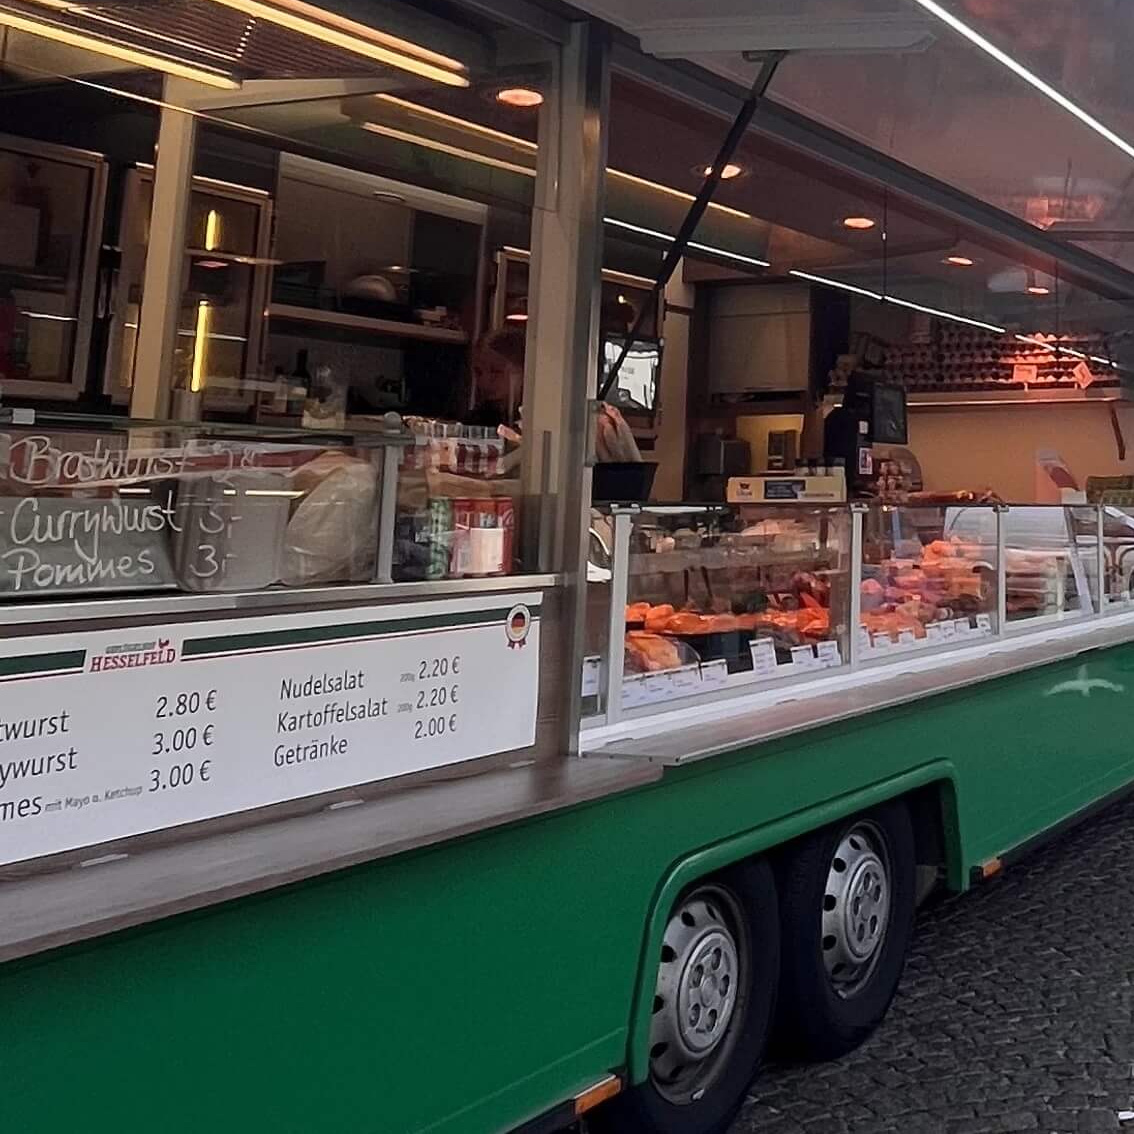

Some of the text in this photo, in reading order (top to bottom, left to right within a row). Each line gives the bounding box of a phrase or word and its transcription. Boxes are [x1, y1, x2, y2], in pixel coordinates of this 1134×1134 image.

[2, 549, 155, 590] Pommes
[89, 648, 177, 673] HESSELFELD
[279, 669, 365, 701] Nudelsalat
[418, 657, 449, 680] 2.20
[451, 655, 461, 675] €
[155, 691, 201, 718] 2.80
[205, 689, 218, 712] €
[277, 697, 389, 734] Kartoffelsalat
[416, 686, 447, 709] 2.20
[450, 684, 459, 704] €
[151, 726, 198, 755] 3.00
[202, 724, 215, 746] €
[273, 713, 458, 767] Getränke 2.00 €
[65, 796, 90, 810] Mayo
[104, 785, 143, 801] Ketchup
[148, 762, 195, 793] 3.00
[199, 759, 212, 782] €
